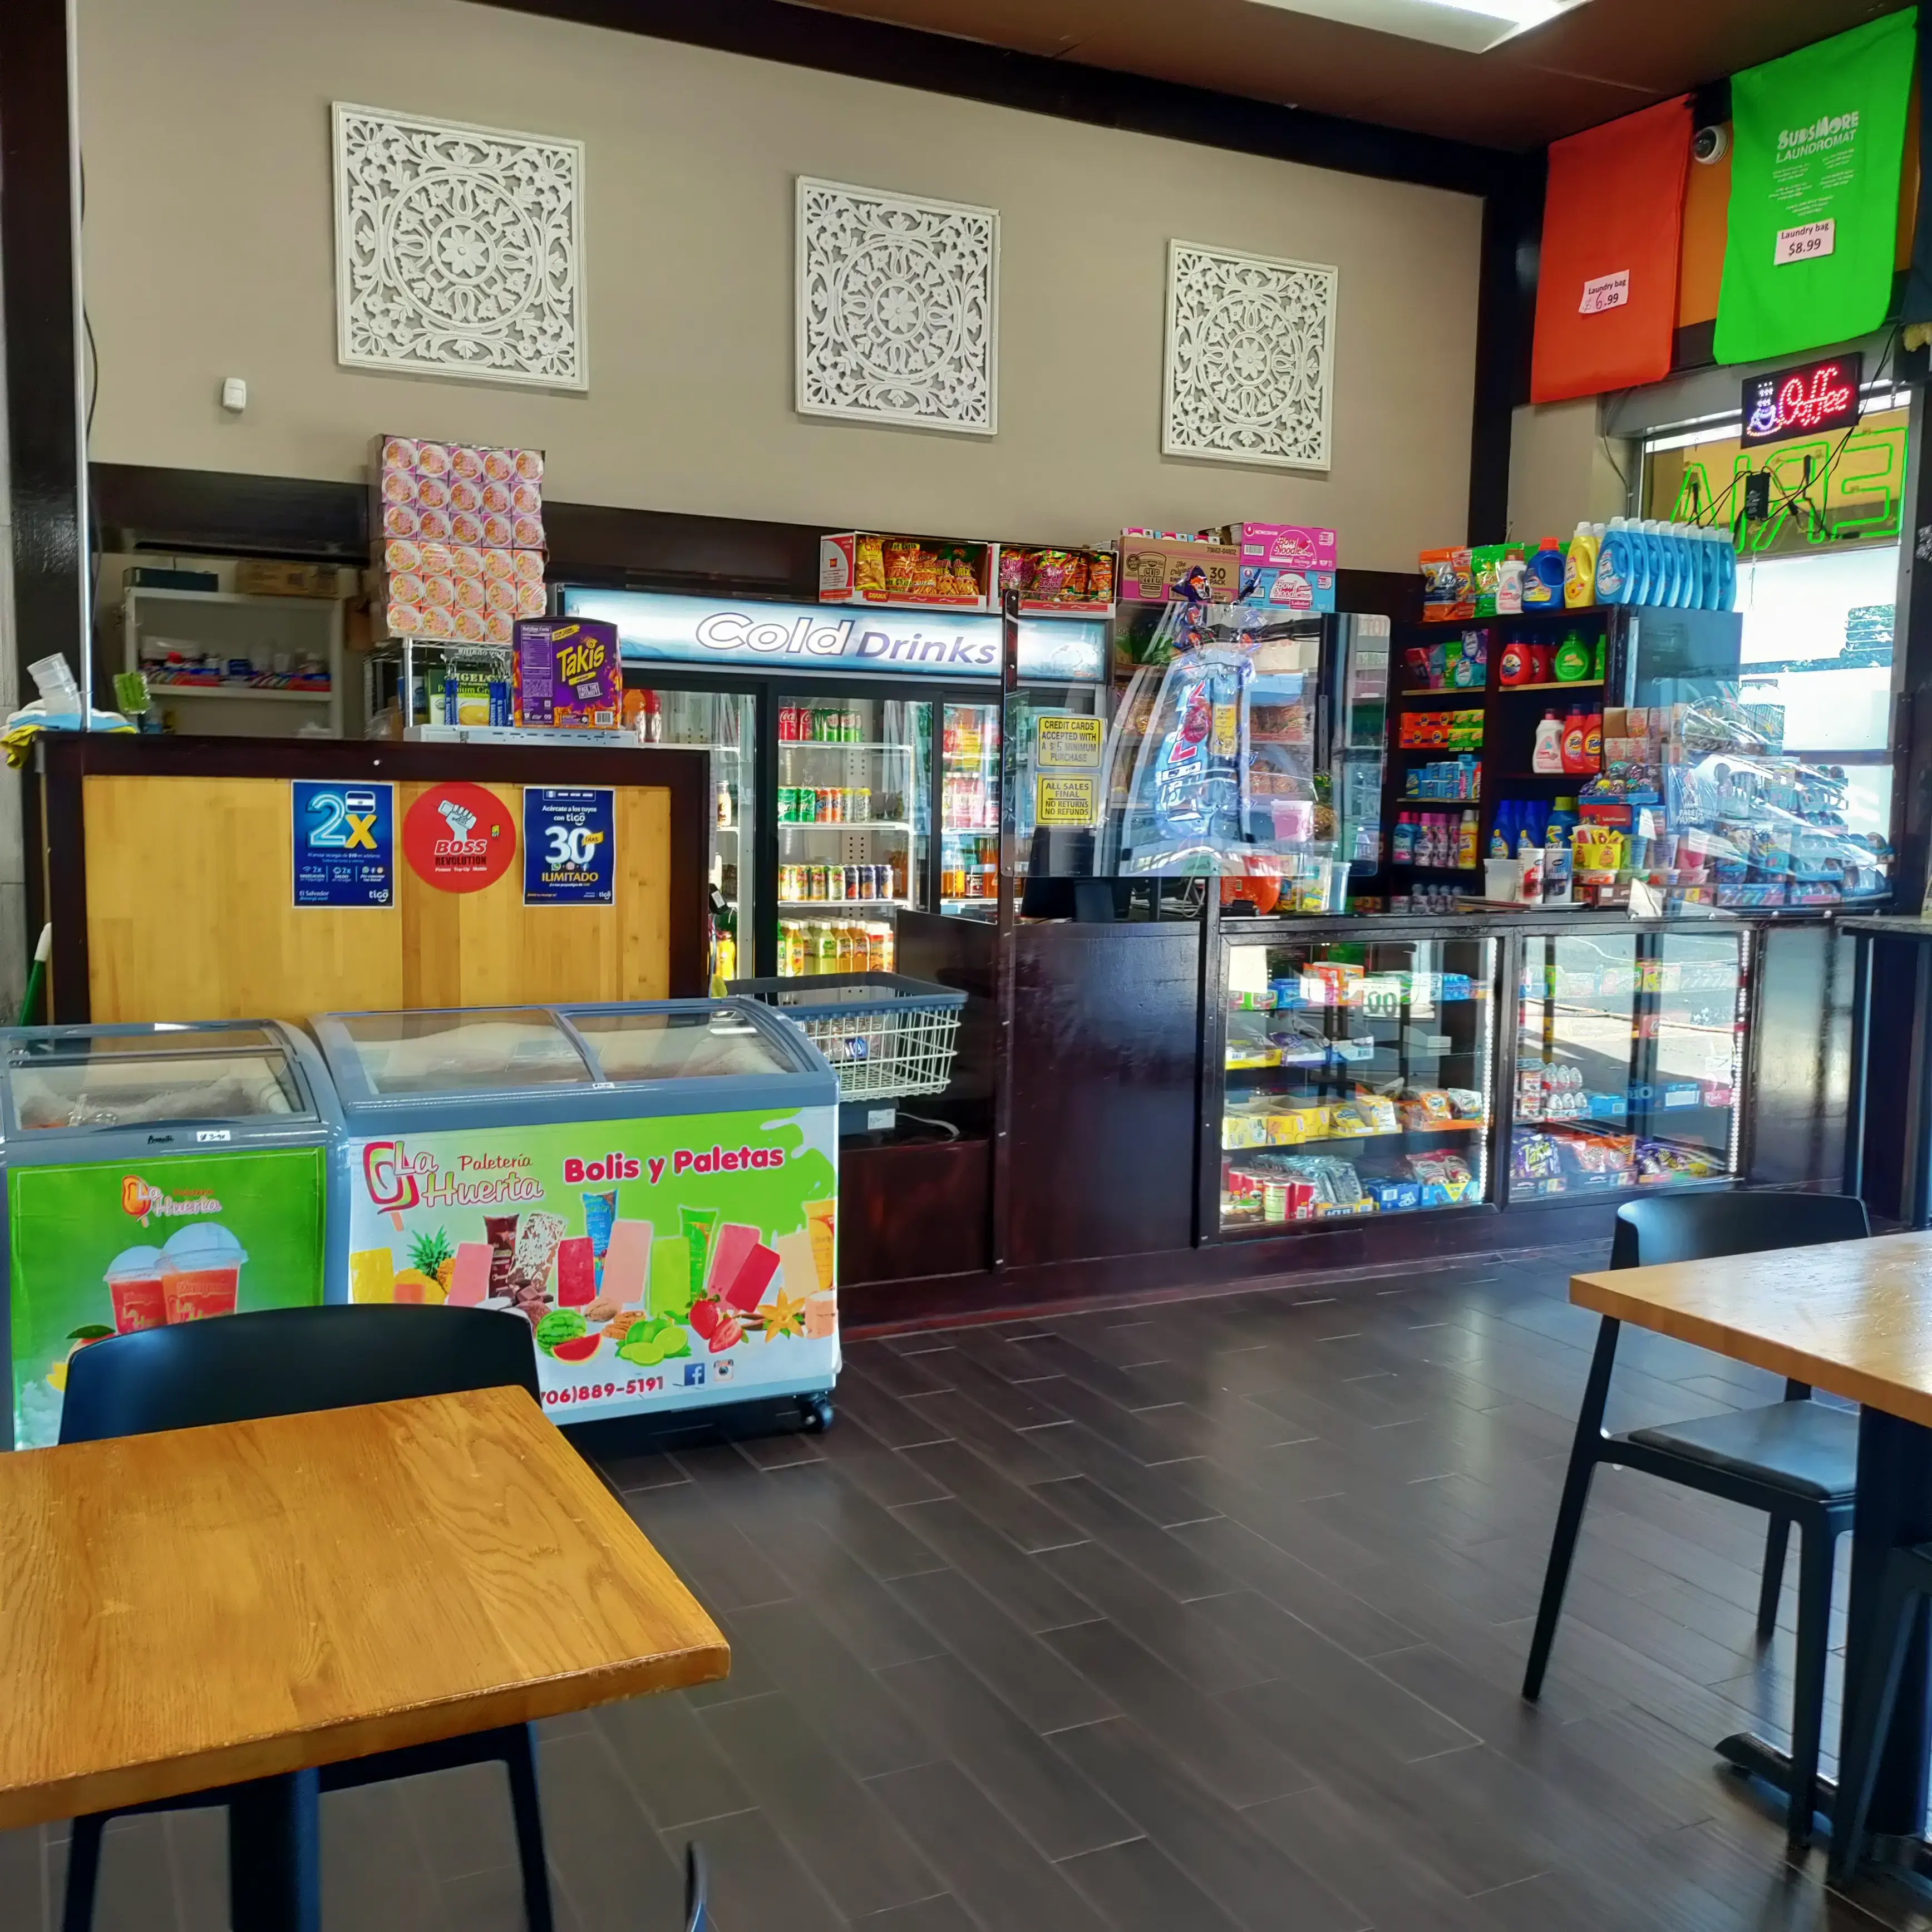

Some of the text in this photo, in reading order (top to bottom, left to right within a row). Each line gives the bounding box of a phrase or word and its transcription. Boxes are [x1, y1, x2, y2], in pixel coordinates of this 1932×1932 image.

[1775, 129, 1857, 164] LAUNDROMAT
[1781, 223, 1830, 240] Laundry bag
[1788, 238, 1821, 257] $8.99
[1588, 279, 1627, 295] Laundry bag
[1778, 366, 1850, 427] Coffee
[1277, 536, 1299, 546] Bowl
[1274, 546, 1303, 556] Noodle
[955, 567, 971, 576] MIX
[1144, 568, 1160, 576] CUP
[1210, 567, 1226, 579] 30
[1276, 580, 1298, 590] Bowl
[1274, 589, 1300, 599] Noodle
[696, 612, 997, 664] Cold Drinks
[556, 636, 605, 682] Takis
[1044, 721, 1069, 730] CREDIT
[1042, 731, 1096, 741] ACCEPTED WITH
[1569, 738, 1581, 747] Tide
[1042, 742, 1046, 750] A
[1065, 743, 1096, 751] MINIMUM
[1051, 753, 1087, 762] PURCHASE
[434, 839, 487, 855] BOSS
[545, 826, 596, 864] 30
[435, 856, 487, 865] REVOLUTION
[541, 872, 599, 882] ILIMITADO
[393, 1141, 438, 1175] La
[457, 1154, 533, 1171] Paletería
[564, 1145, 785, 1184] Bolis y Paletas
[137, 1181, 162, 1200] La
[421, 1171, 544, 1208] Huerta
[152, 1196, 222, 1216] Huerta
